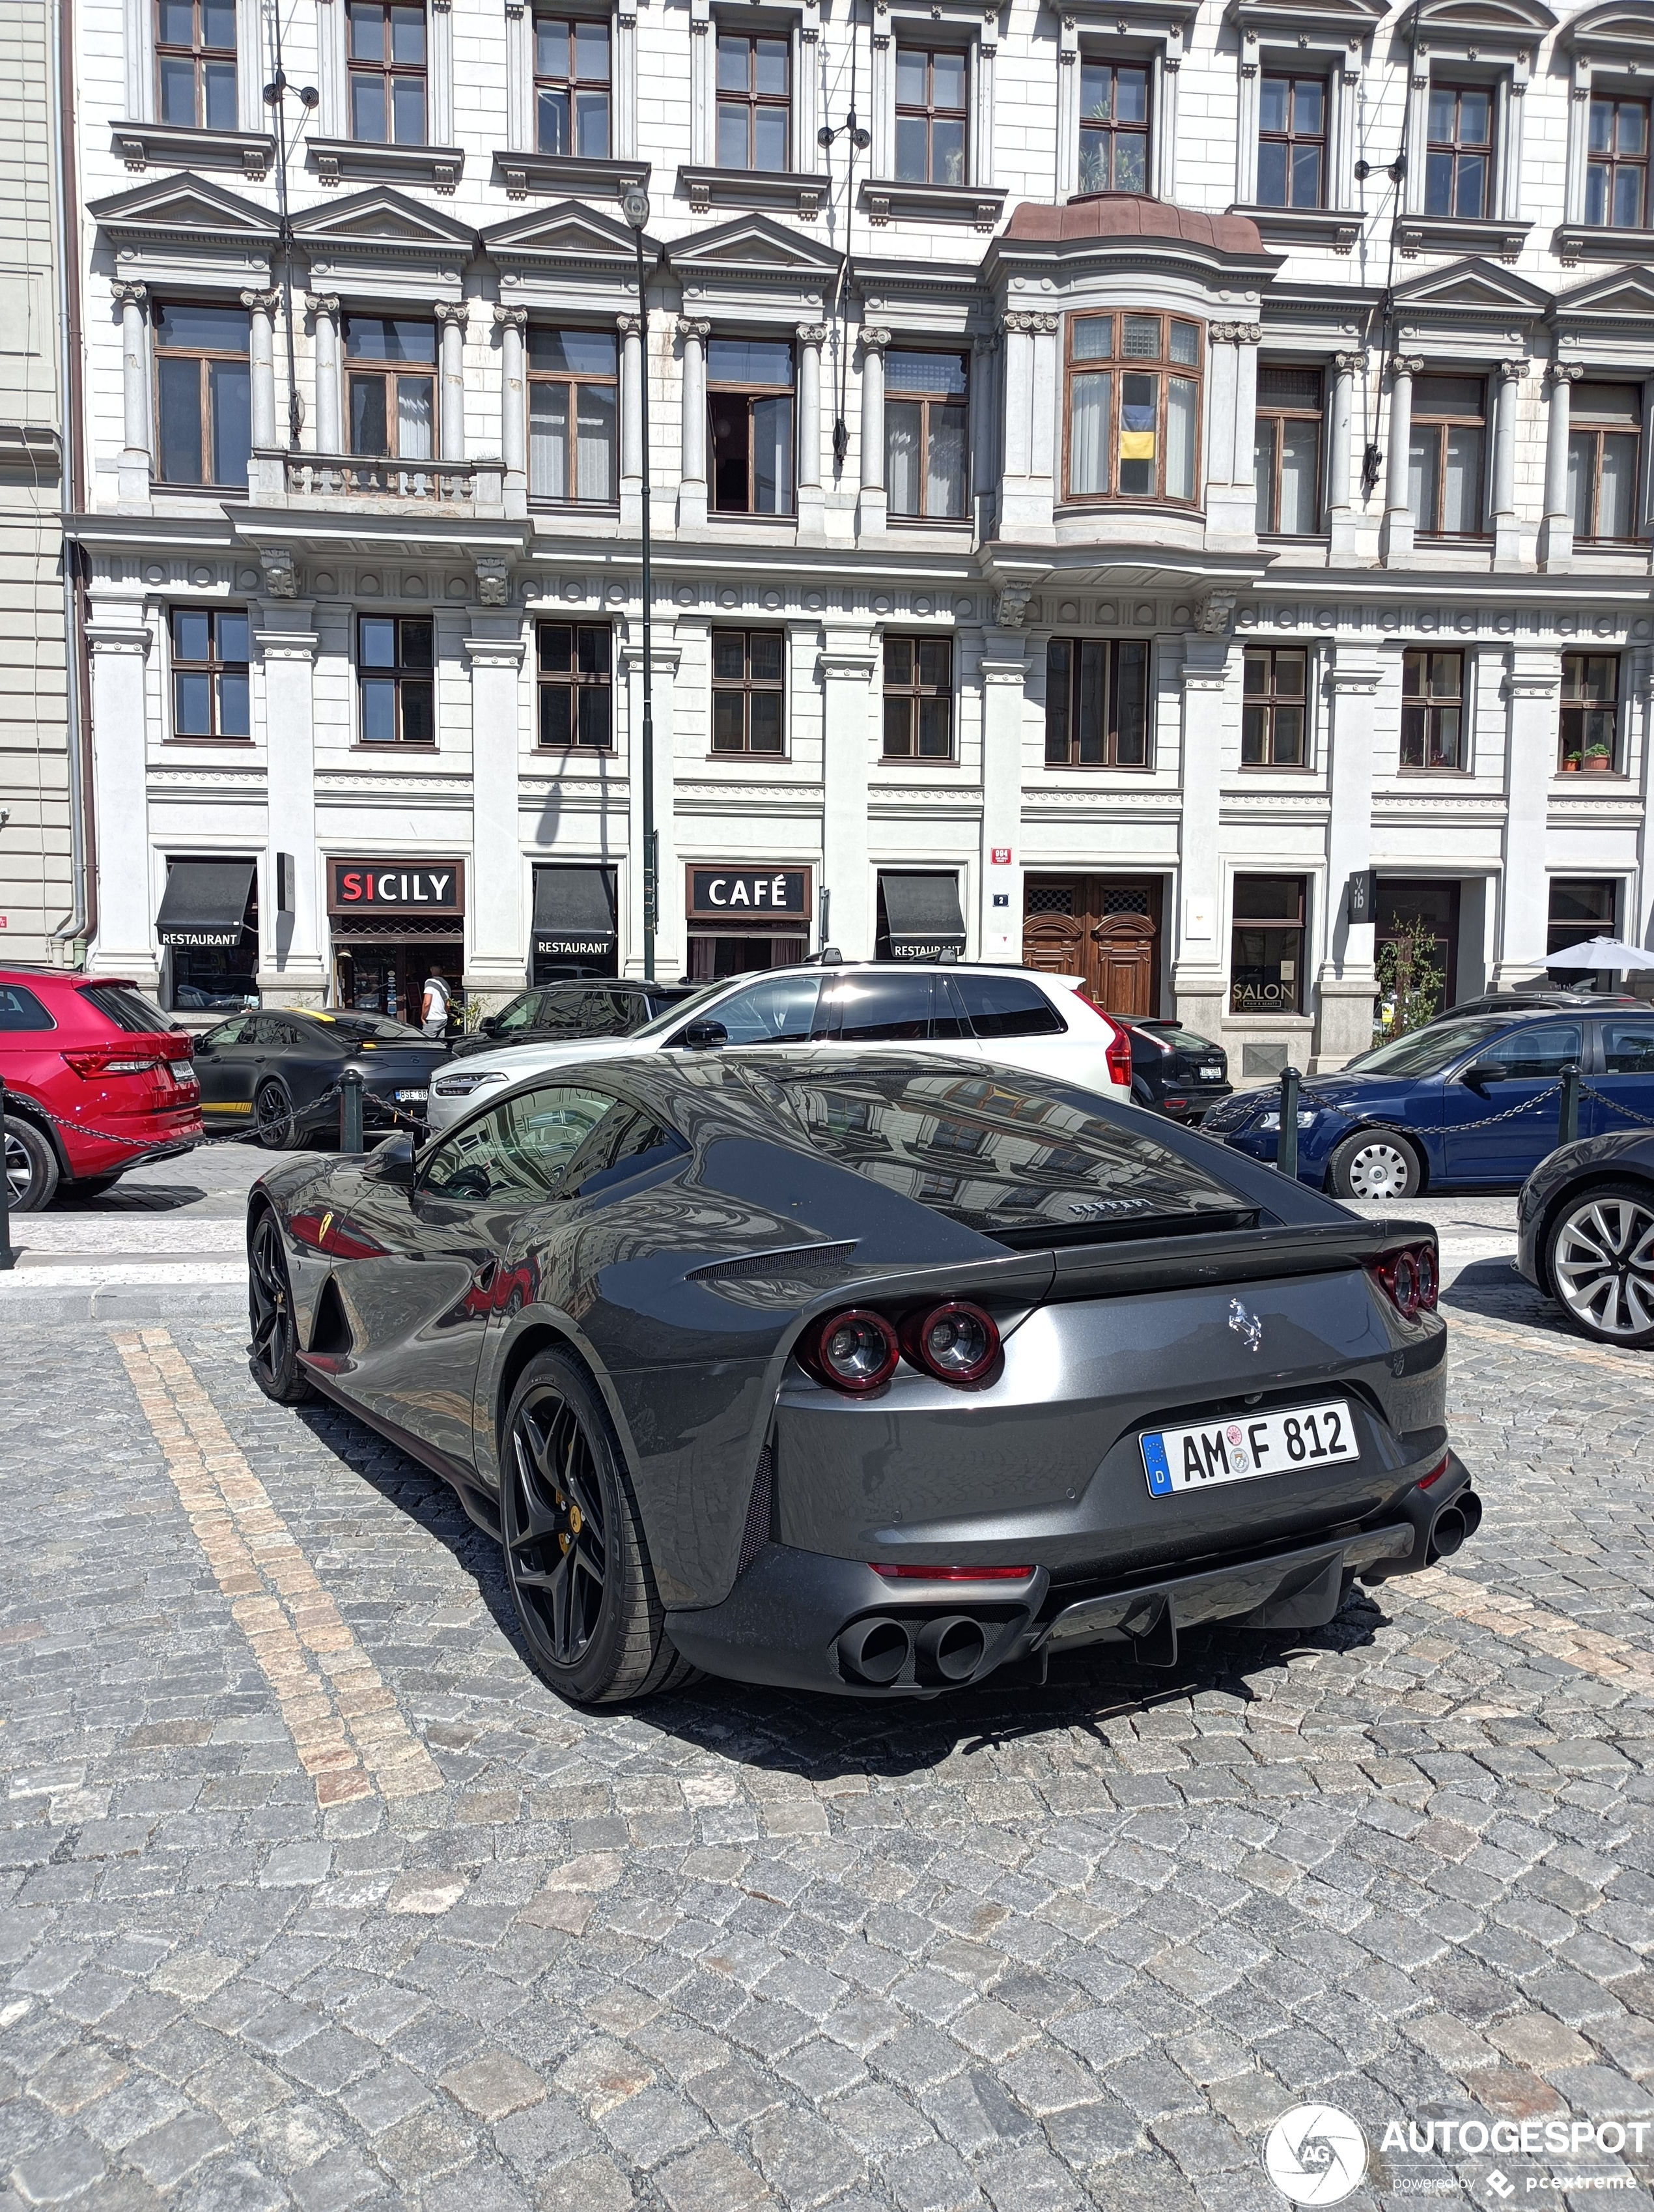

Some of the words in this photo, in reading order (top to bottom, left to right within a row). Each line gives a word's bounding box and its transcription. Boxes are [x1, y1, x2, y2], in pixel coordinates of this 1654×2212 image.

[343, 873, 450, 900] SICILY
[708, 873, 787, 905] CAFÉ
[162, 933, 238, 945] RESTAURANT
[539, 942, 609, 954] RESTAURANT
[895, 946, 962, 956] RESTAURT
[1232, 984, 1295, 1000] SALON
[400, 1090, 414, 1099] 8SE
[418, 1090, 428, 1098] 88
[1183, 1430, 1230, 1482] AM
[1248, 1423, 1269, 1469] F
[1283, 1411, 1347, 1461] 812
[1155, 1470, 1164, 1484] D
